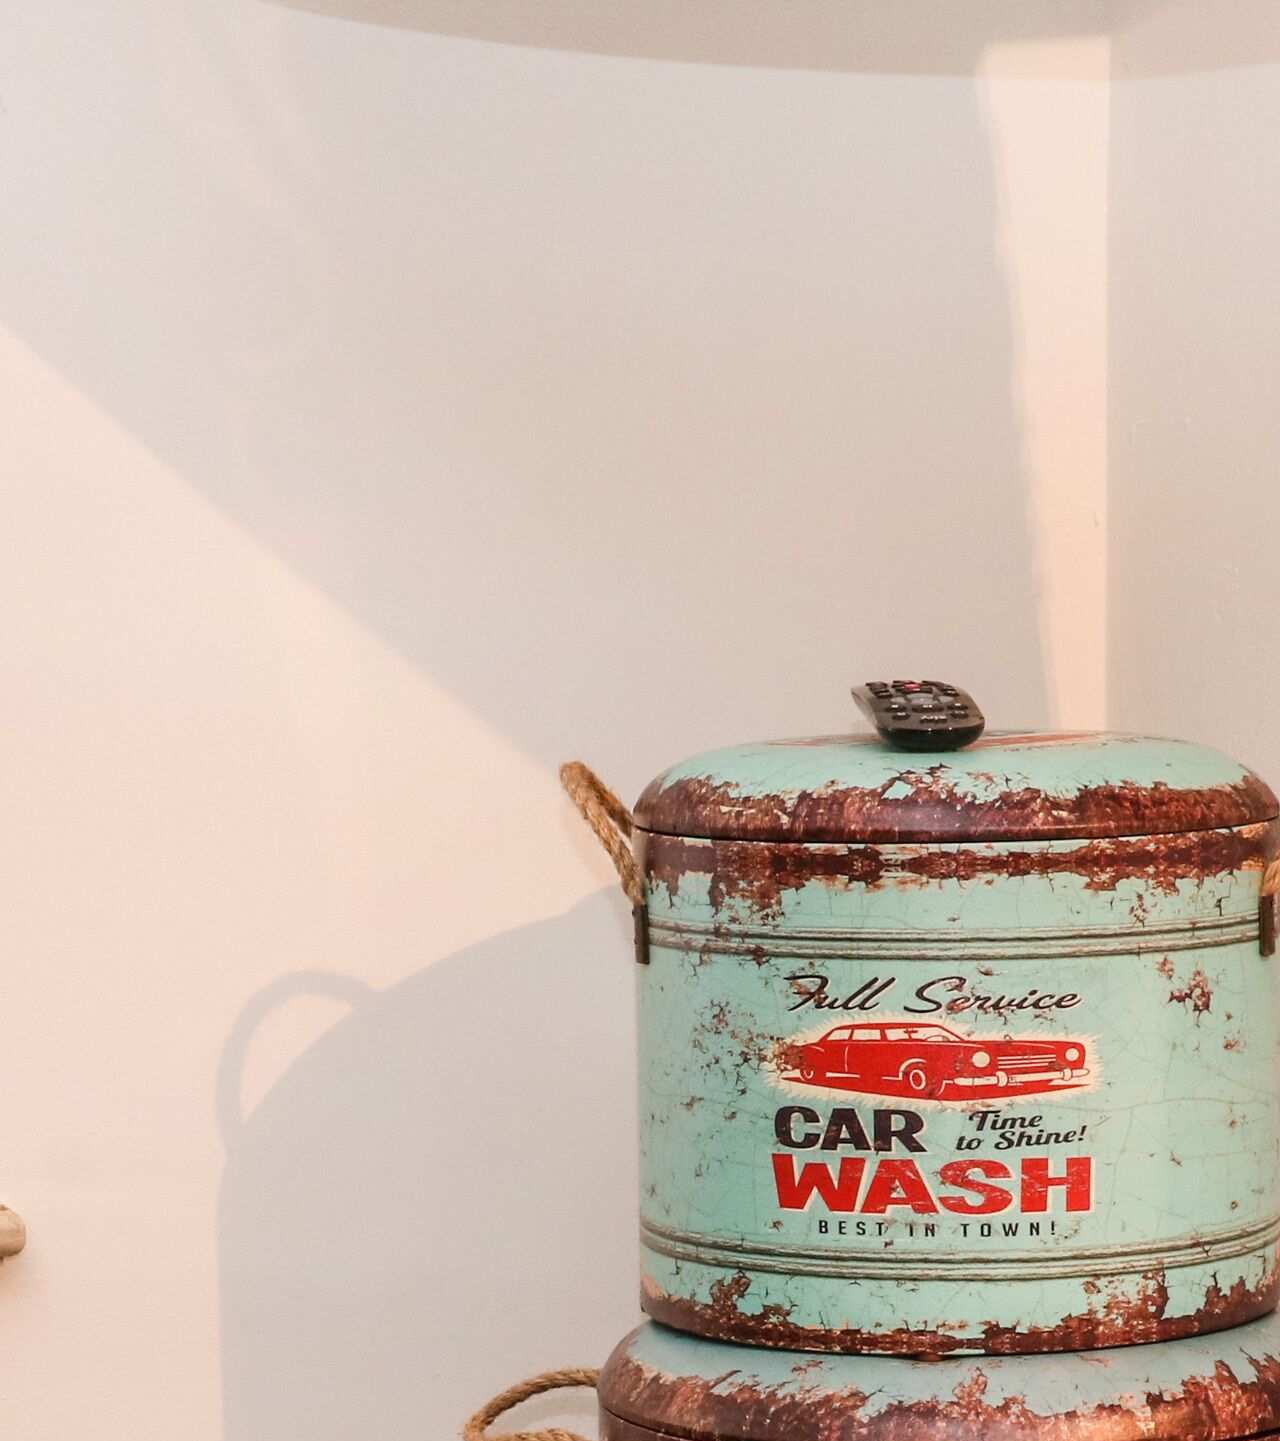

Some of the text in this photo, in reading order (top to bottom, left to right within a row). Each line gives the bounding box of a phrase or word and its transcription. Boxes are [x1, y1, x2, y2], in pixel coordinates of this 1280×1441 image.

[783, 974, 1082, 1014] Full Service
[774, 1106, 928, 1153] CAR
[969, 1110, 1043, 1132] Time
[956, 1125, 1088, 1151] to Shine!
[771, 1153, 1093, 1215] WASH
[819, 1220, 1056, 1238] BEST IN TOWN!
